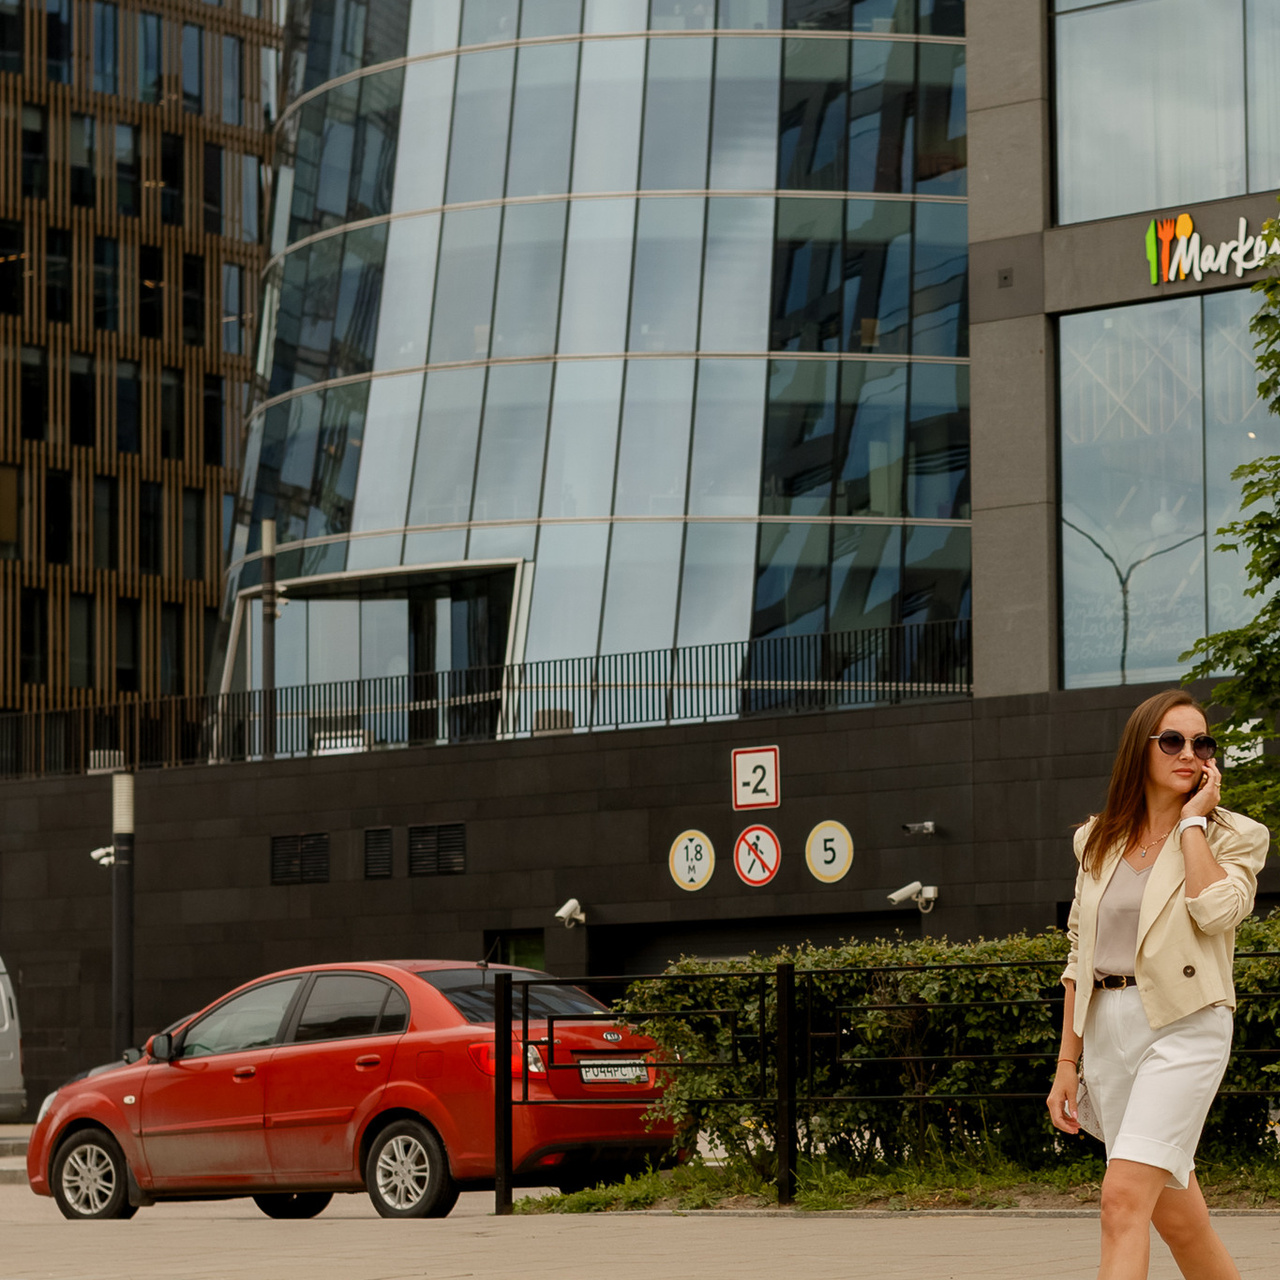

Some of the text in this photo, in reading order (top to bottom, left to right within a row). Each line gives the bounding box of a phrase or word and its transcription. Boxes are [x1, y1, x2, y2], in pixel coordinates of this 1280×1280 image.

[742, 765, 768, 795] -2
[684, 844, 703, 863] 1,8
[823, 838, 836, 865] 5
